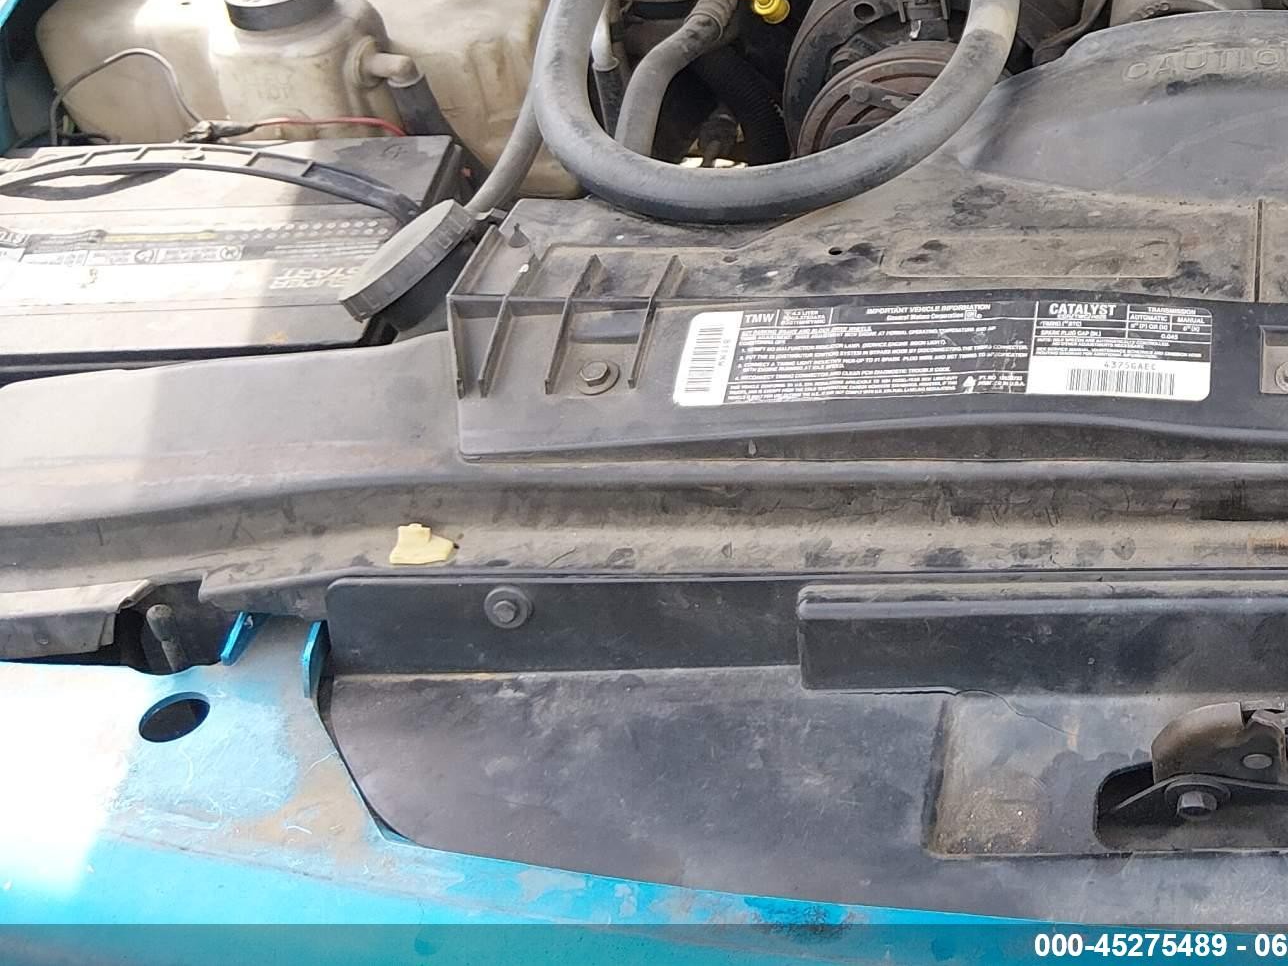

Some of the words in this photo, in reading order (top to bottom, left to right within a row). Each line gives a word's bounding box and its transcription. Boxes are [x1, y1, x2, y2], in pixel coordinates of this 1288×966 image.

[1049, 303, 1117, 316] CATALYST
[1147, 306, 1197, 315] TRANSMISSION
[744, 313, 775, 323] TMW
[1177, 316, 1206, 324] MANUAL
